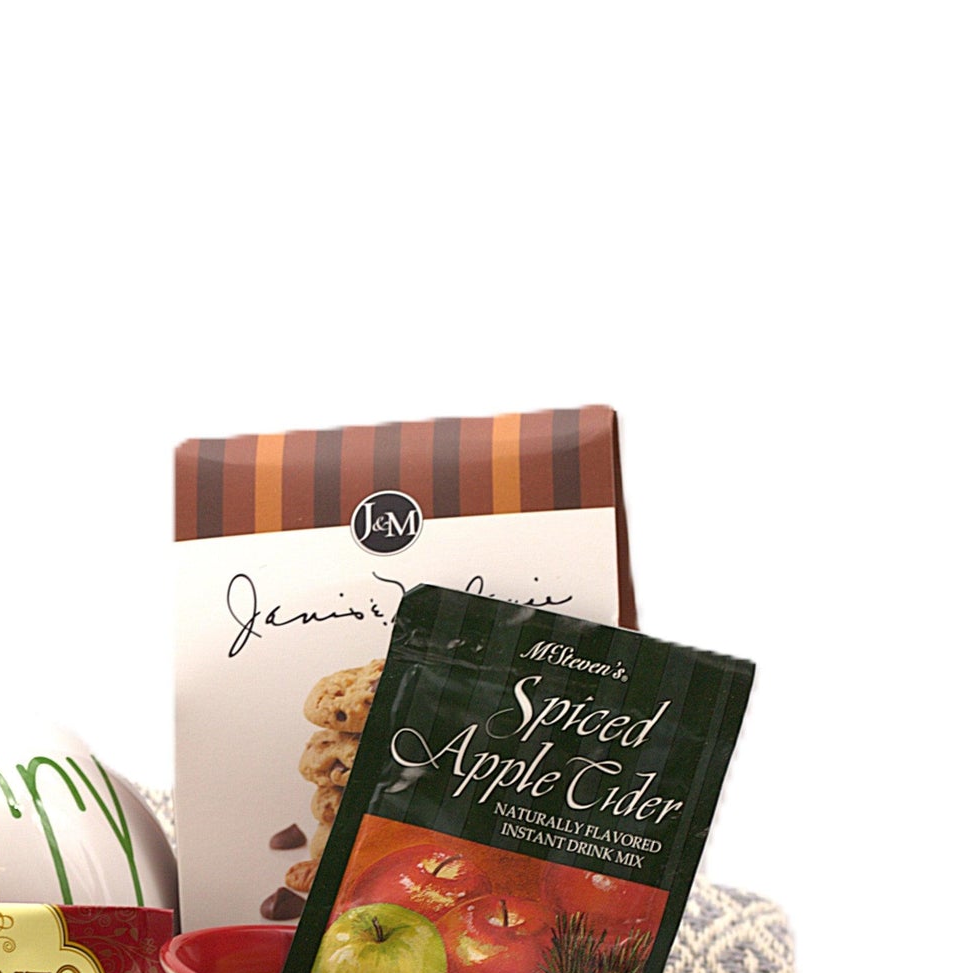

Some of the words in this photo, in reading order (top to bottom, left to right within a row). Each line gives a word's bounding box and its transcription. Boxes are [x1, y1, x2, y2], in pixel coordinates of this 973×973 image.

[486, 675, 671, 748] Spiced
[391, 724, 561, 804] Apple
[566, 756, 683, 824] Cider
[494, 802, 585, 836] NATURALLY
[584, 825, 662, 854] FLAVORED
[500, 821, 568, 852] INSTANT
[566, 839, 613, 862] DRINK
[615, 850, 645, 869] MIX
